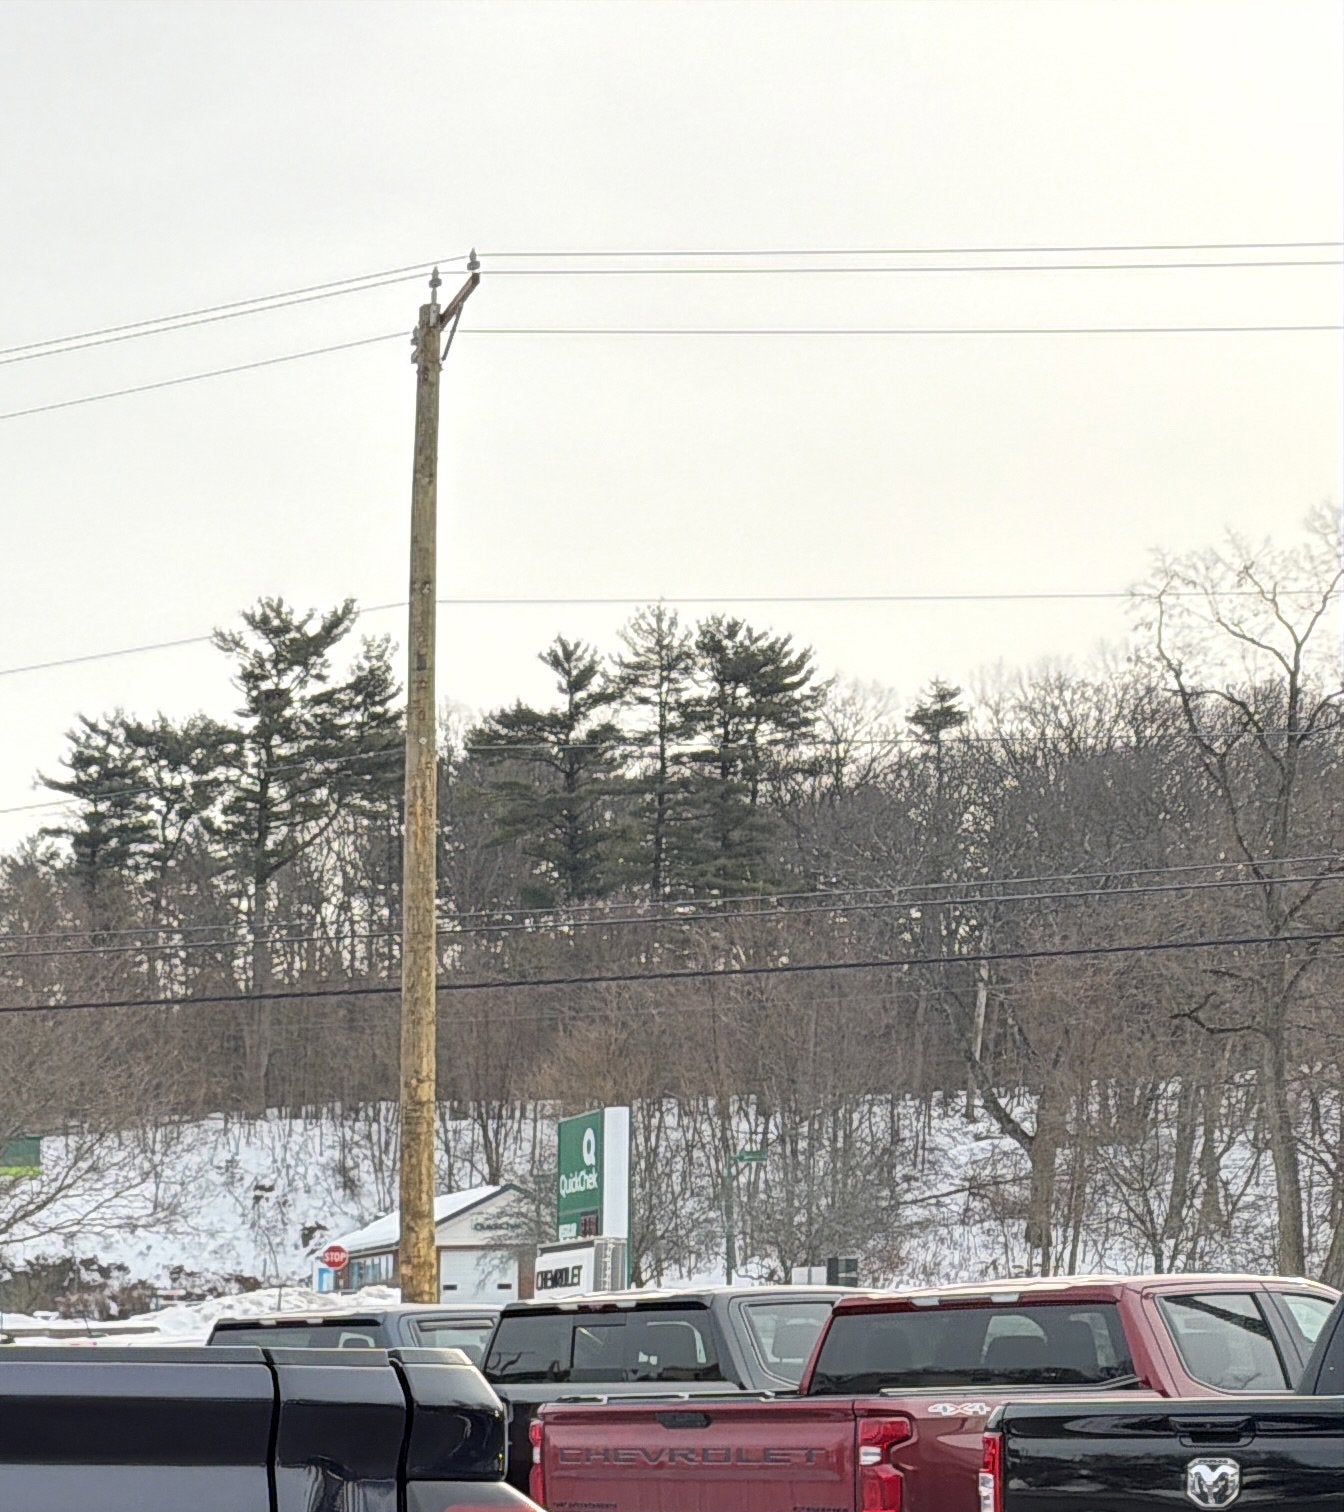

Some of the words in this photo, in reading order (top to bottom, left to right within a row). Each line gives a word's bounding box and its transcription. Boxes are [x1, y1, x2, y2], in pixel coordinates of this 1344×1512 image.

[560, 1168, 598, 1198] QuickChek
[323, 1251, 347, 1263] STOP
[536, 1265, 582, 1290] CHEVROLET
[559, 1446, 827, 1466] CHEVROLET
